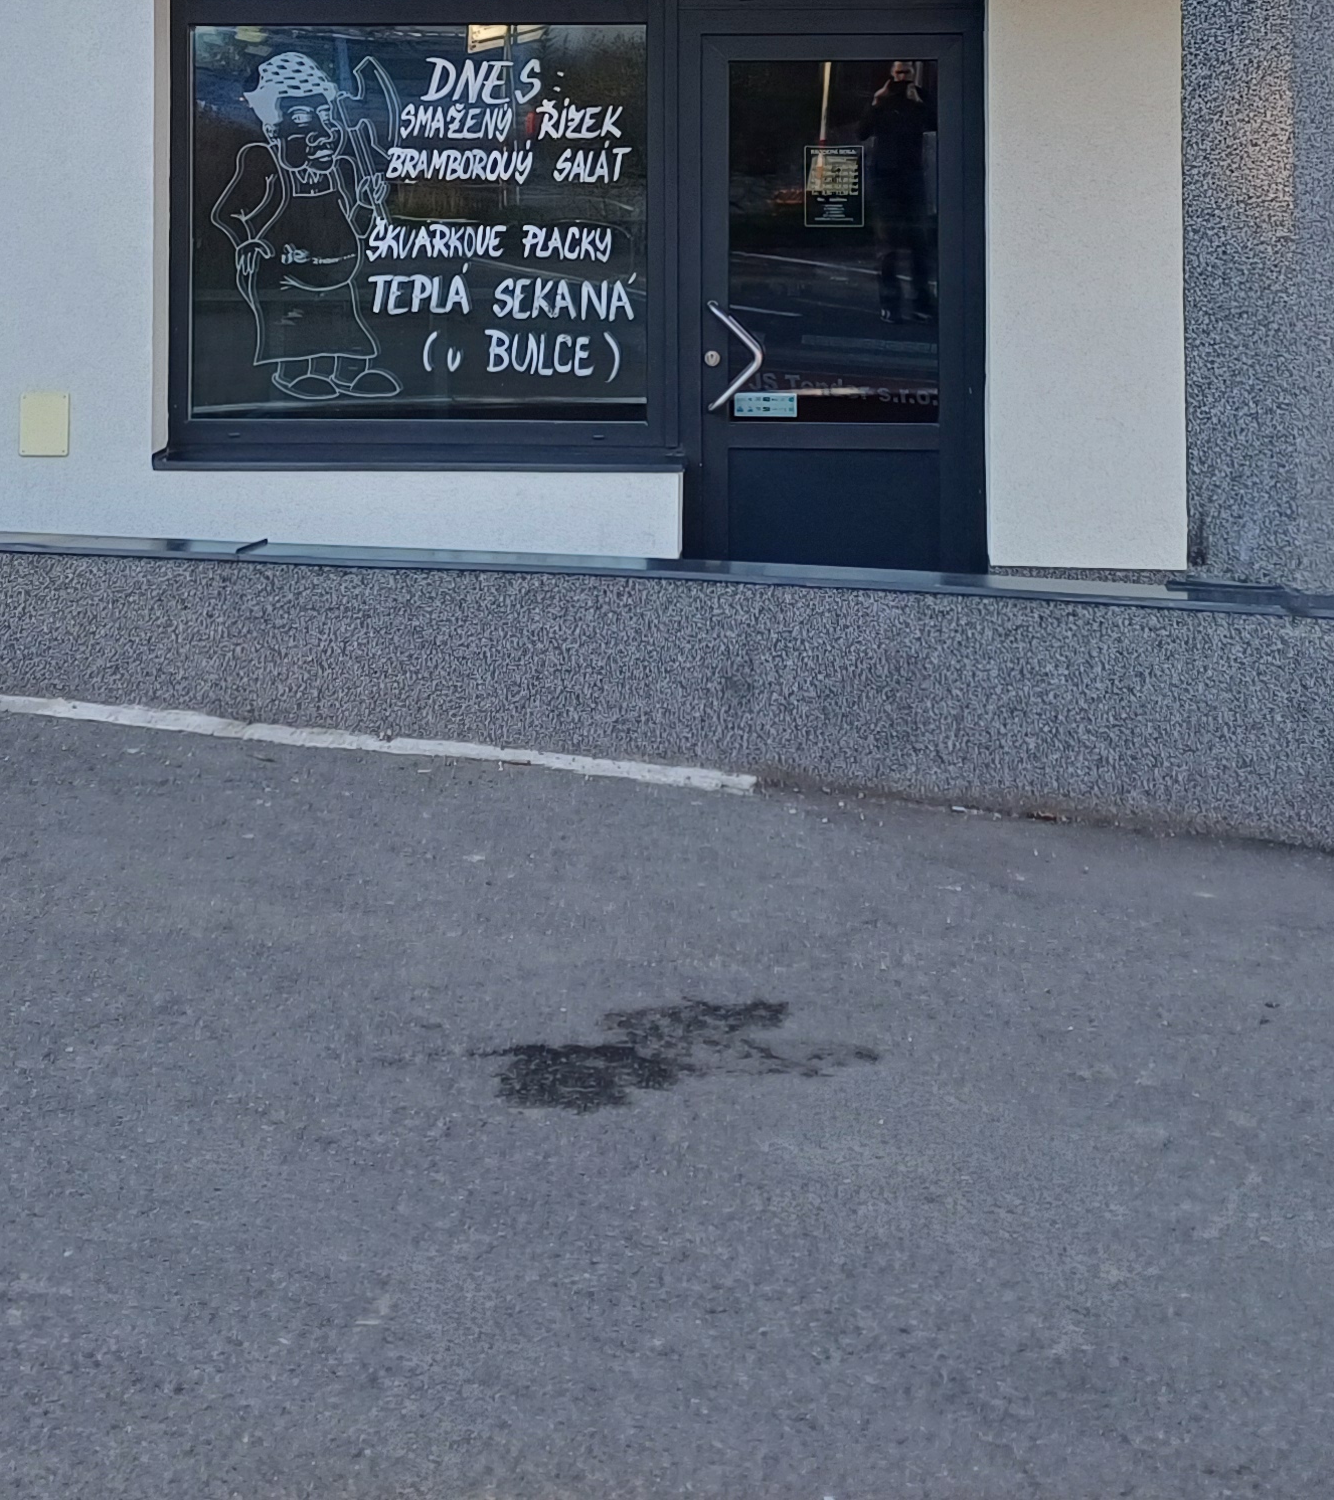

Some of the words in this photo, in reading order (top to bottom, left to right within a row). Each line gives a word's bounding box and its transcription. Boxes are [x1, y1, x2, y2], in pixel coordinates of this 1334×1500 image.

[400, 102, 512, 142] SMAŽENÝ
[536, 98, 623, 140] ŘÍZEK
[386, 140, 533, 184] BRAMBOROVÝ
[553, 140, 632, 183] SALÁT
[522, 224, 611, 263] PLACKY
[368, 263, 472, 316] TEPLÁ
[492, 272, 637, 322] SEKANÁ
